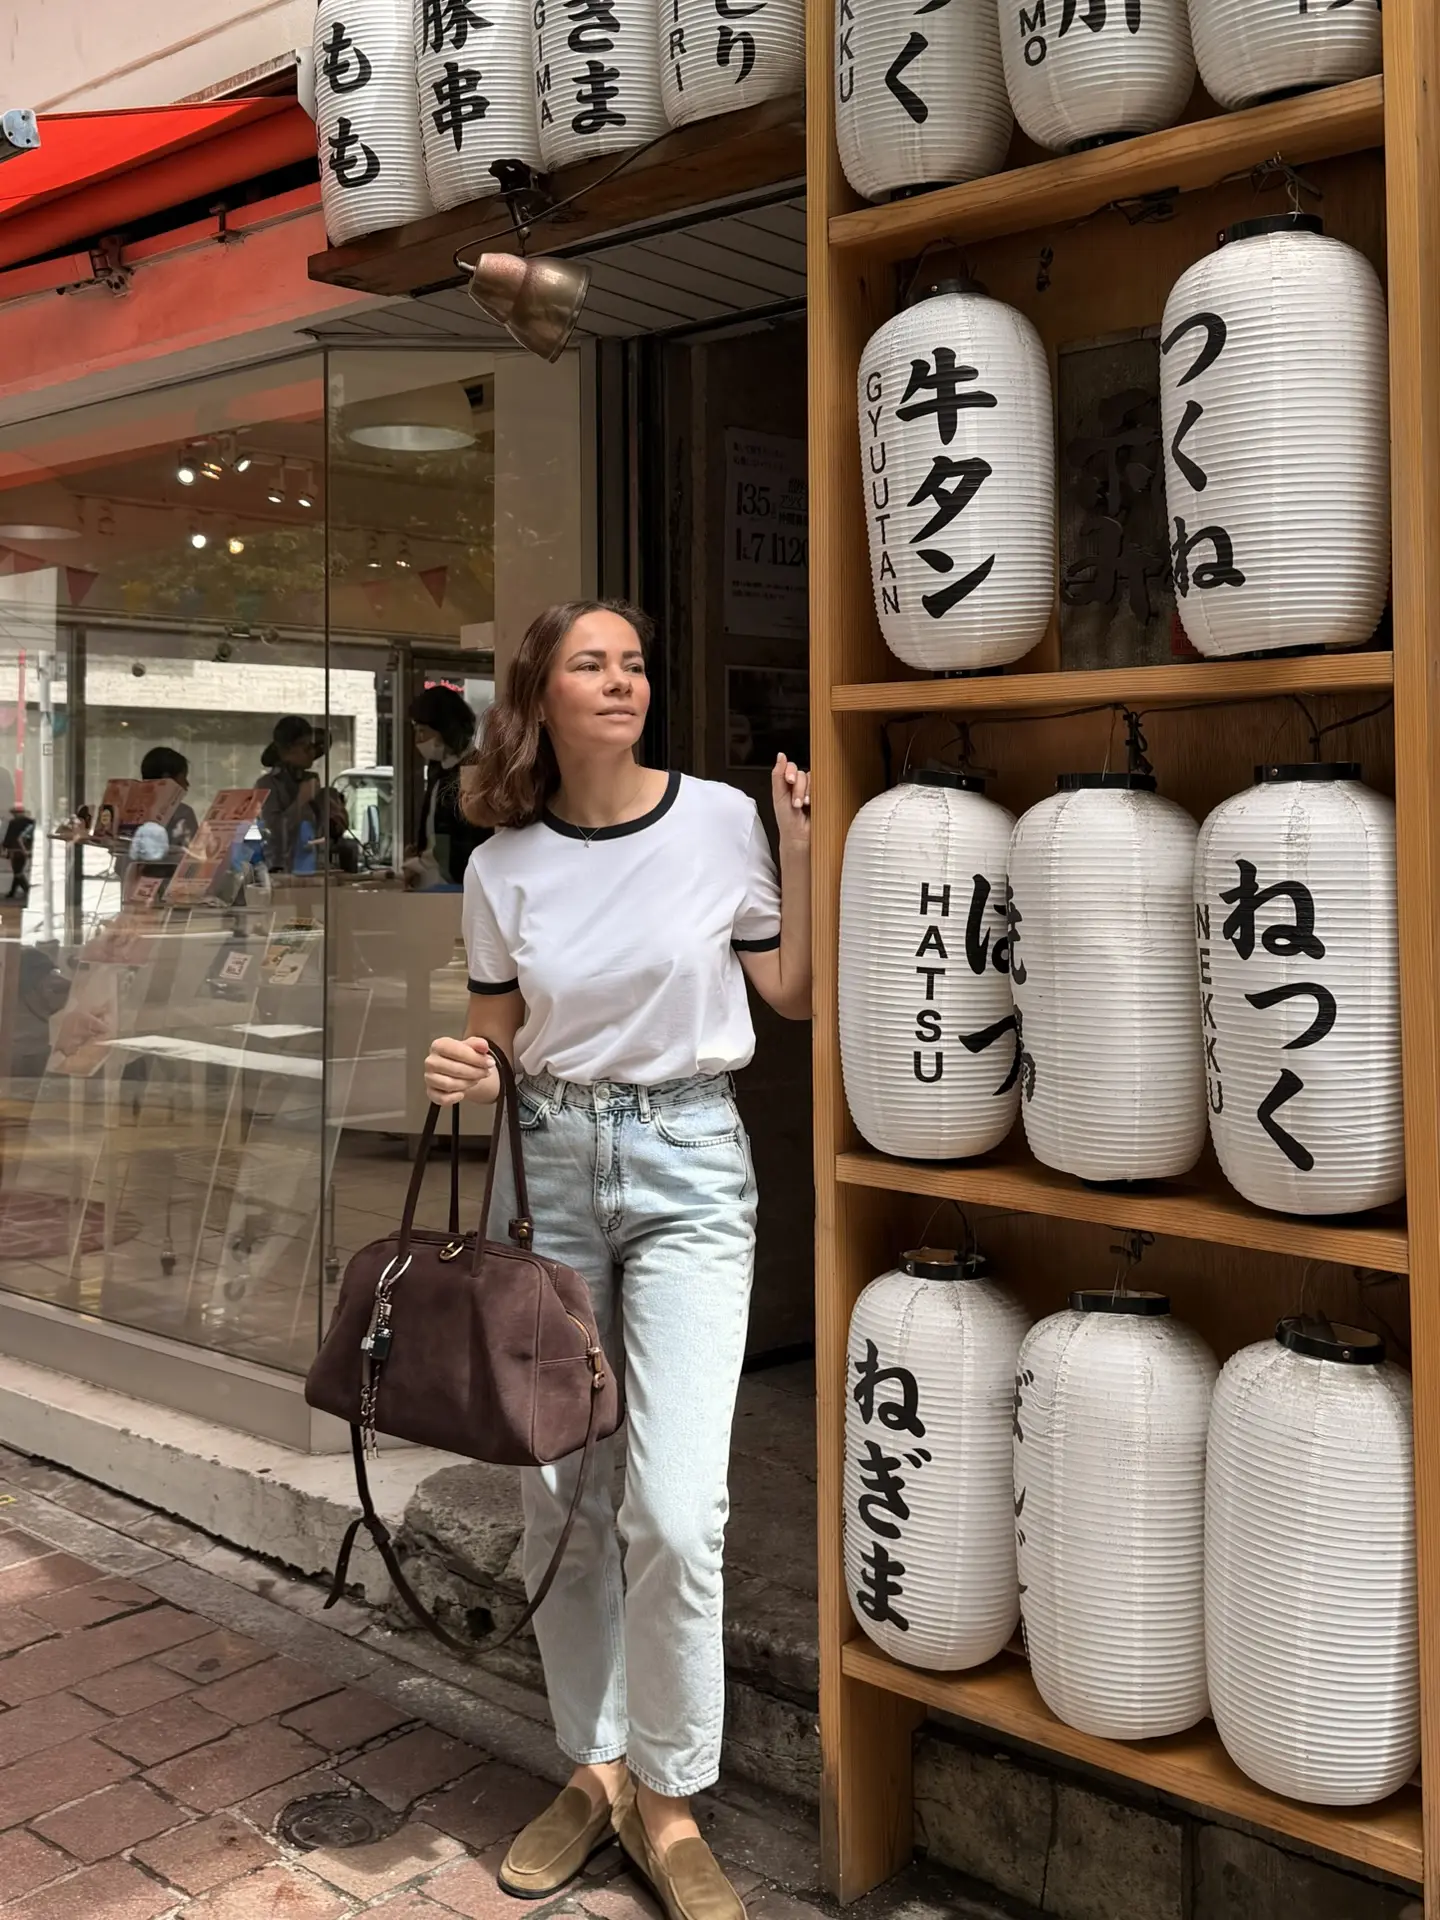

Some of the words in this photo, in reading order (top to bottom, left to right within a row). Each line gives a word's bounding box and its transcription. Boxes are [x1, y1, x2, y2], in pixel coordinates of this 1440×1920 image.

[323, 22, 381, 189] もも
[533, 0, 554, 129] GIMA
[715, 0, 768, 84] り
[866, 371, 900, 614] GYUUTAN
[895, 347, 998, 618] 牛タン
[1161, 311, 1245, 598] つくね
[913, 882, 951, 1083] HATSU
[1196, 904, 1223, 1114] NEKKU
[853, 1338, 932, 1632] ねぎま
